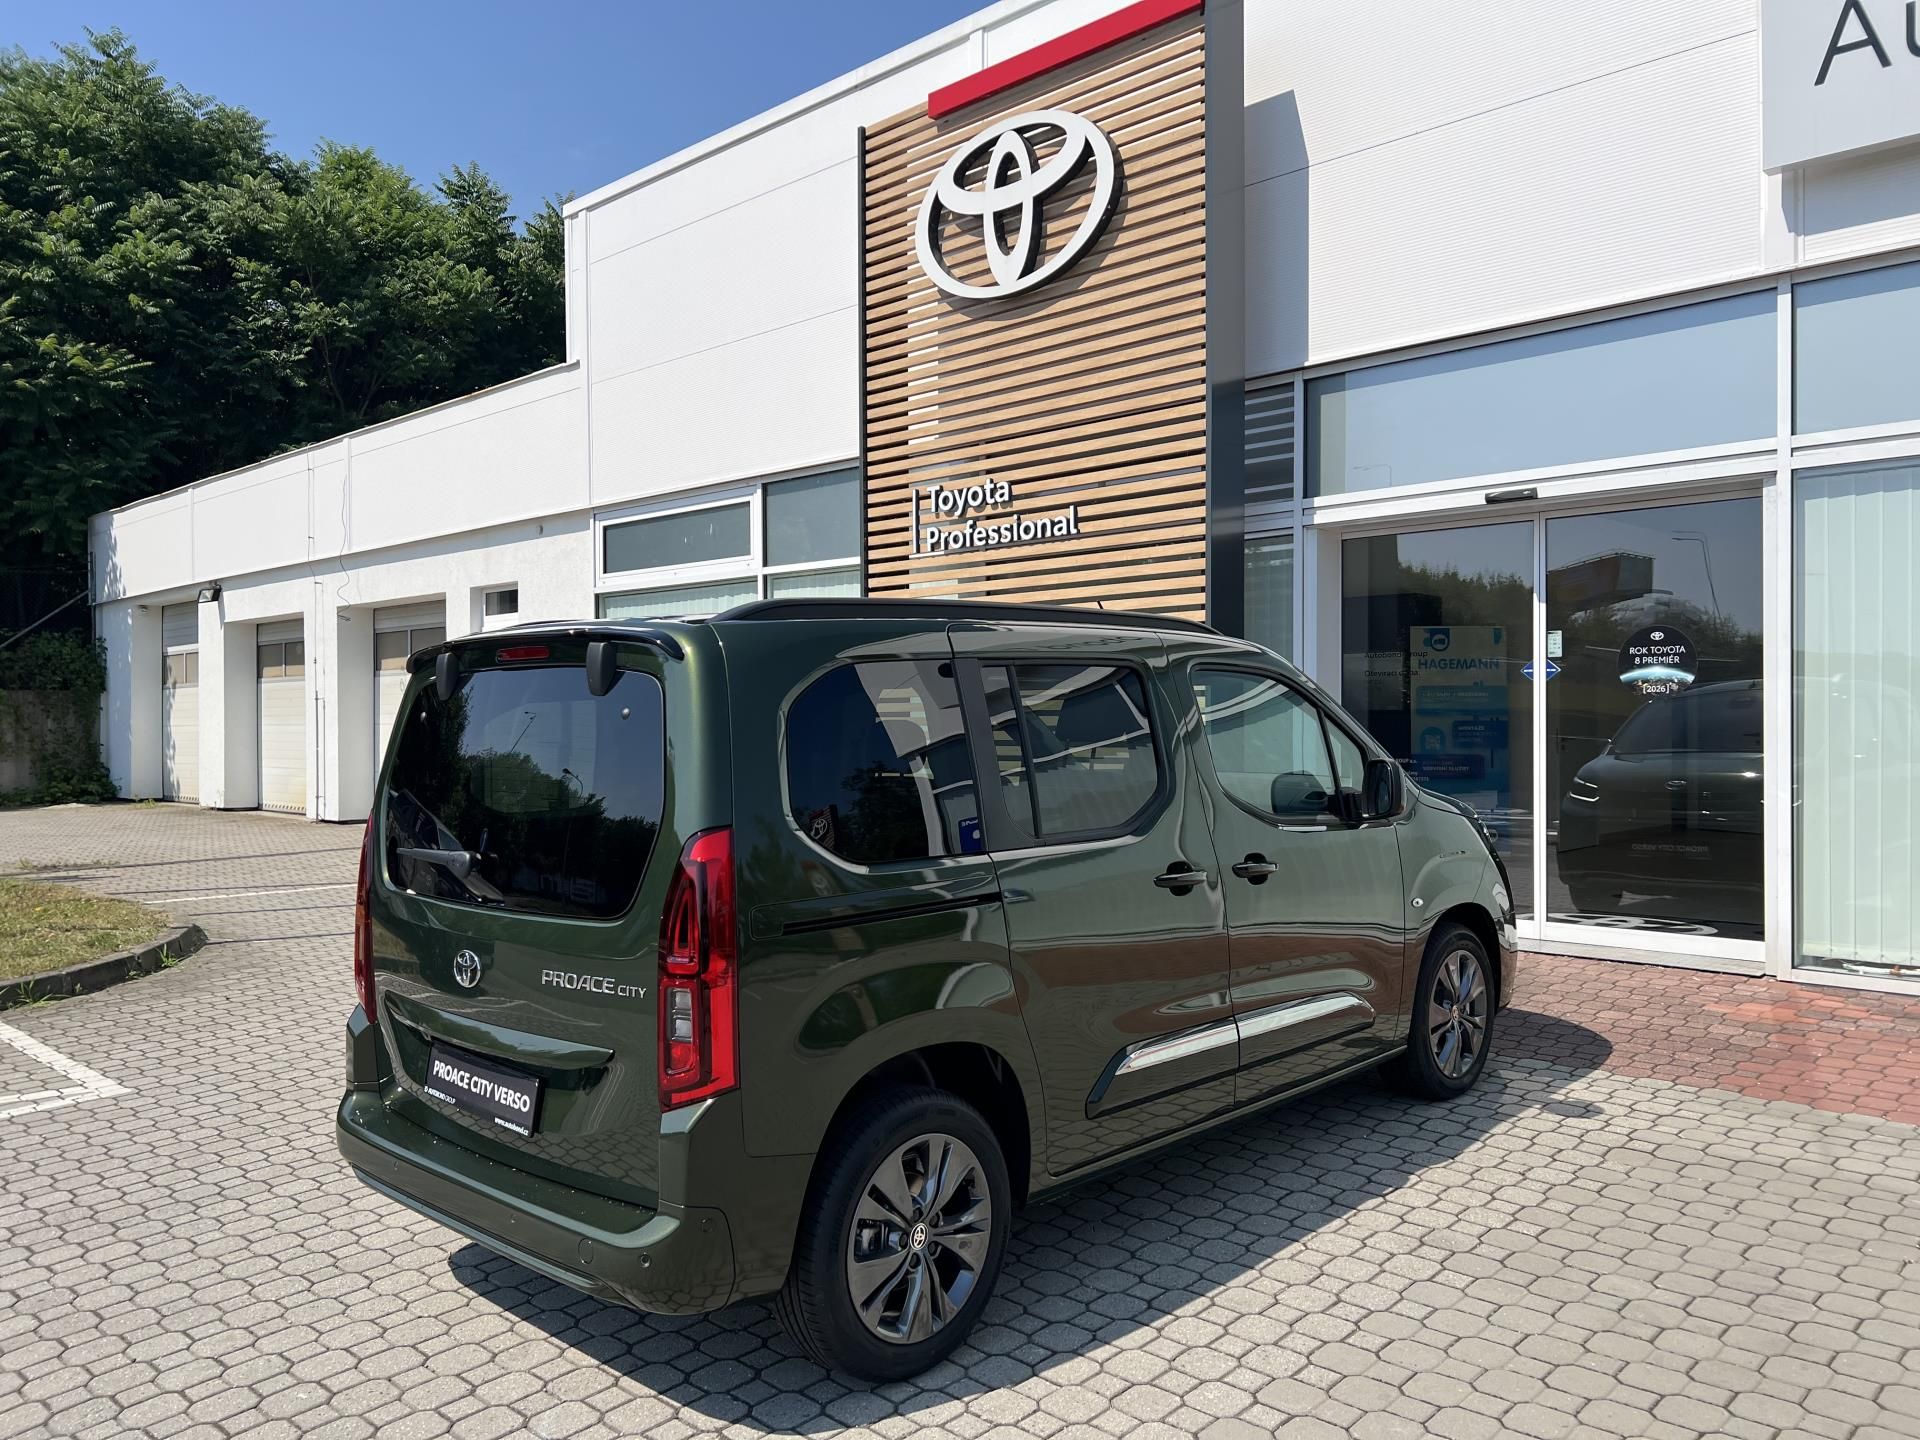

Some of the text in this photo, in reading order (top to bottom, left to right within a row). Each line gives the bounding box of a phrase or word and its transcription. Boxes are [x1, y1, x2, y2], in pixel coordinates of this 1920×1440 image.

[926, 478, 1010, 516] Toyota
[926, 505, 1078, 552] Professional
[1418, 658, 1500, 670] HAGEMANN
[1629, 645, 1686, 655] ROK TOYOTA
[1634, 655, 1680, 664] 8 PREMIÉR
[541, 969, 647, 999] PROACE CITY
[432, 1059, 531, 1113] PROACE CITY VERSO
